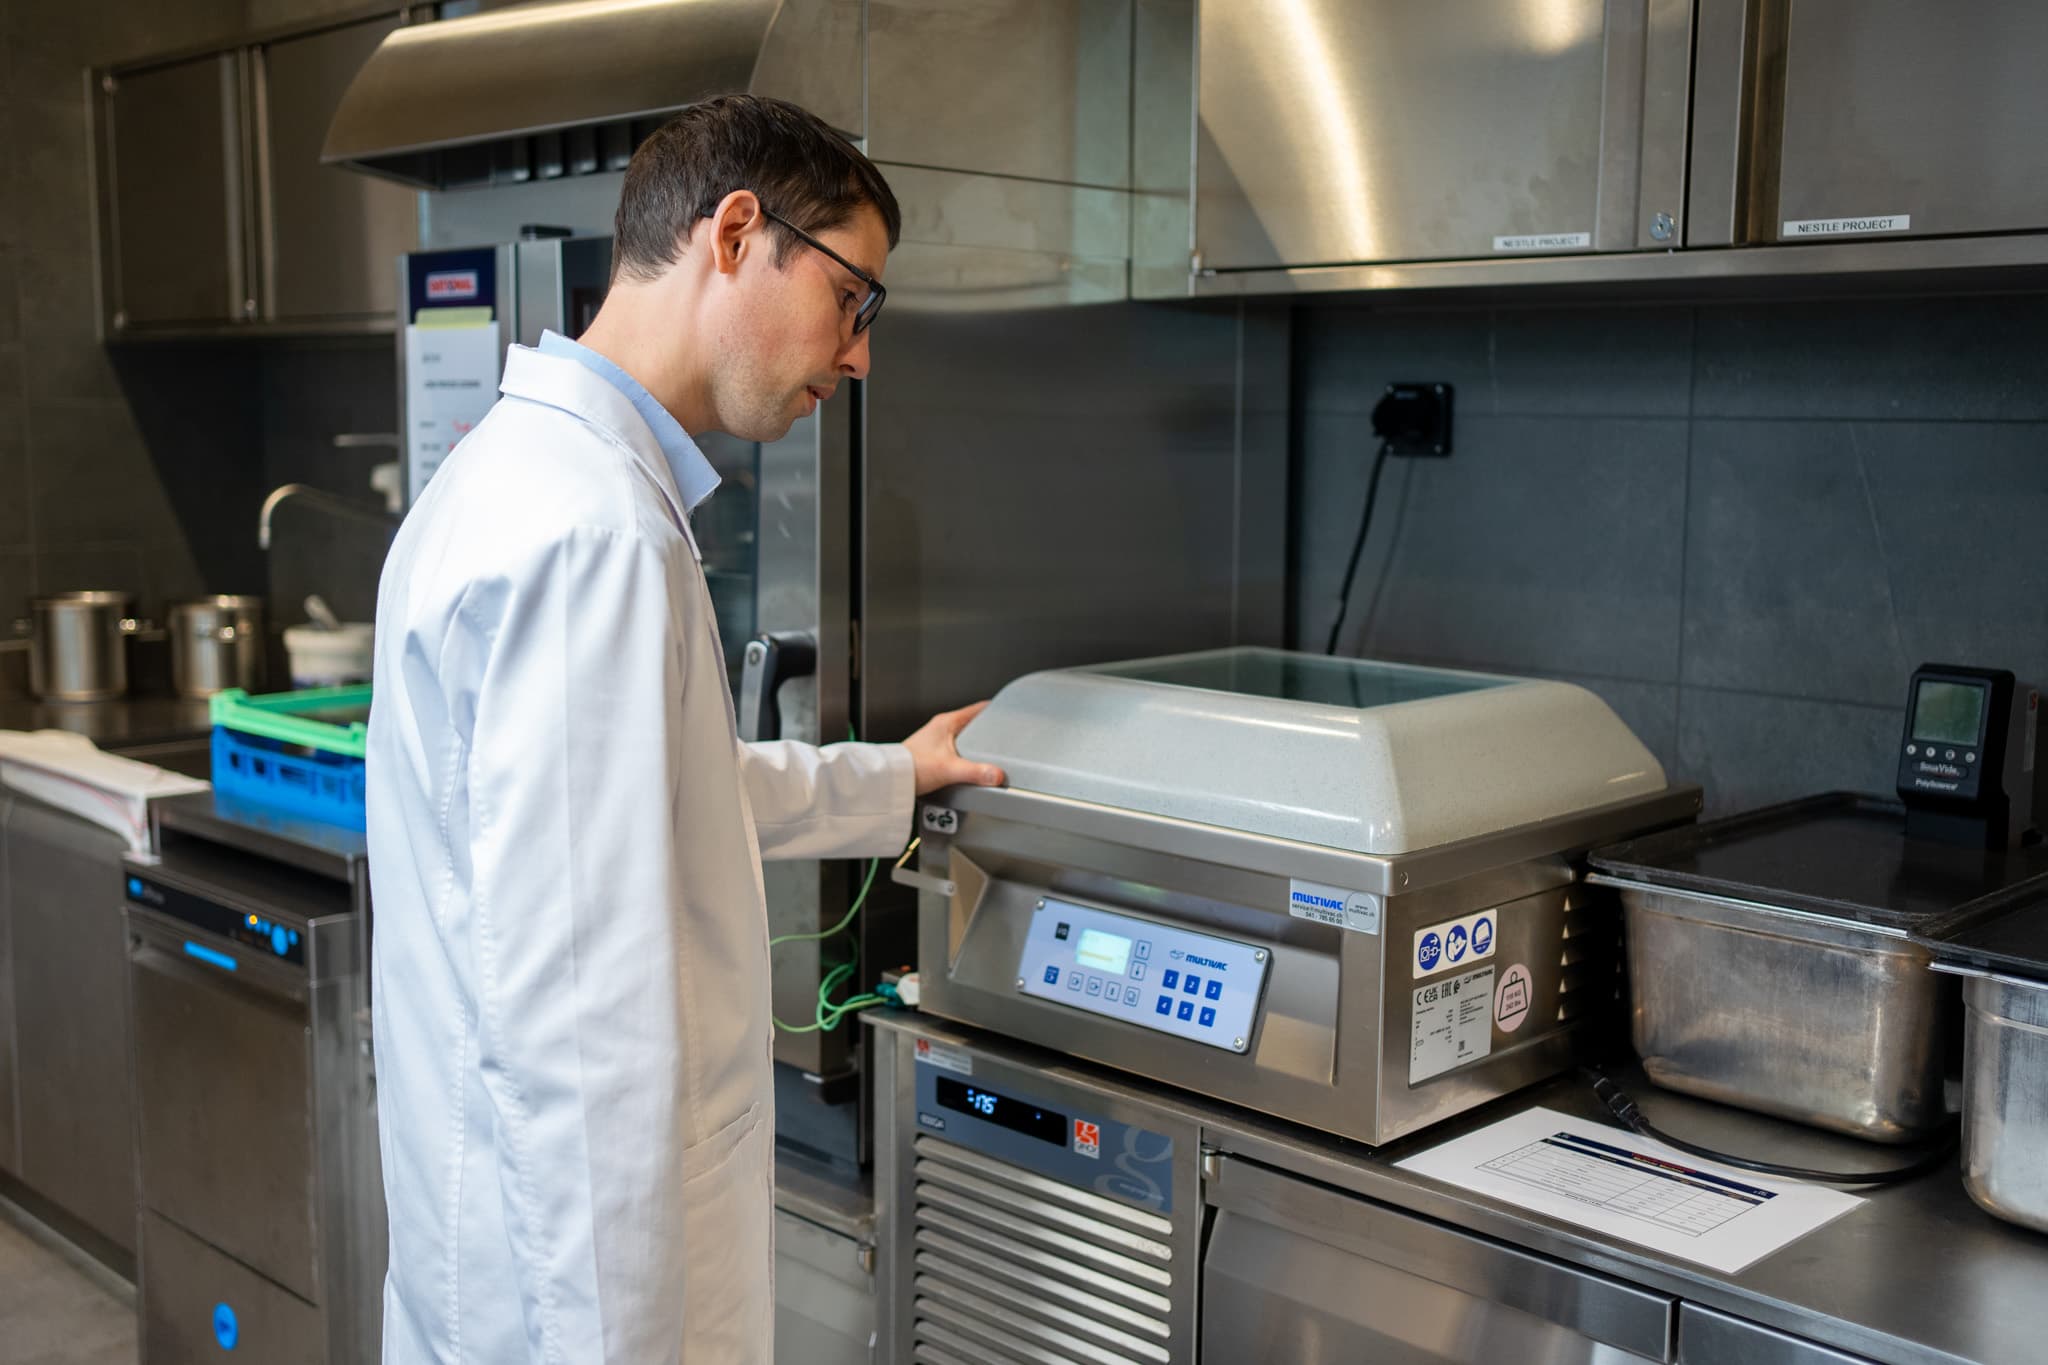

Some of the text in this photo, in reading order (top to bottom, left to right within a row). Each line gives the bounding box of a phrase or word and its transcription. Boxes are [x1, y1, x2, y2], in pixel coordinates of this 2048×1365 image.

[1798, 219, 1895, 233] NESTLE PROJECT
[1503, 235, 1580, 248] NESTLE PROJECT
[1292, 891, 1344, 911] MULTIVAC
[1186, 953, 1228, 971] MULTIVAC
[1167, 975, 1217, 994] 1 2 3
[1183, 1007, 1189, 1015] 5
